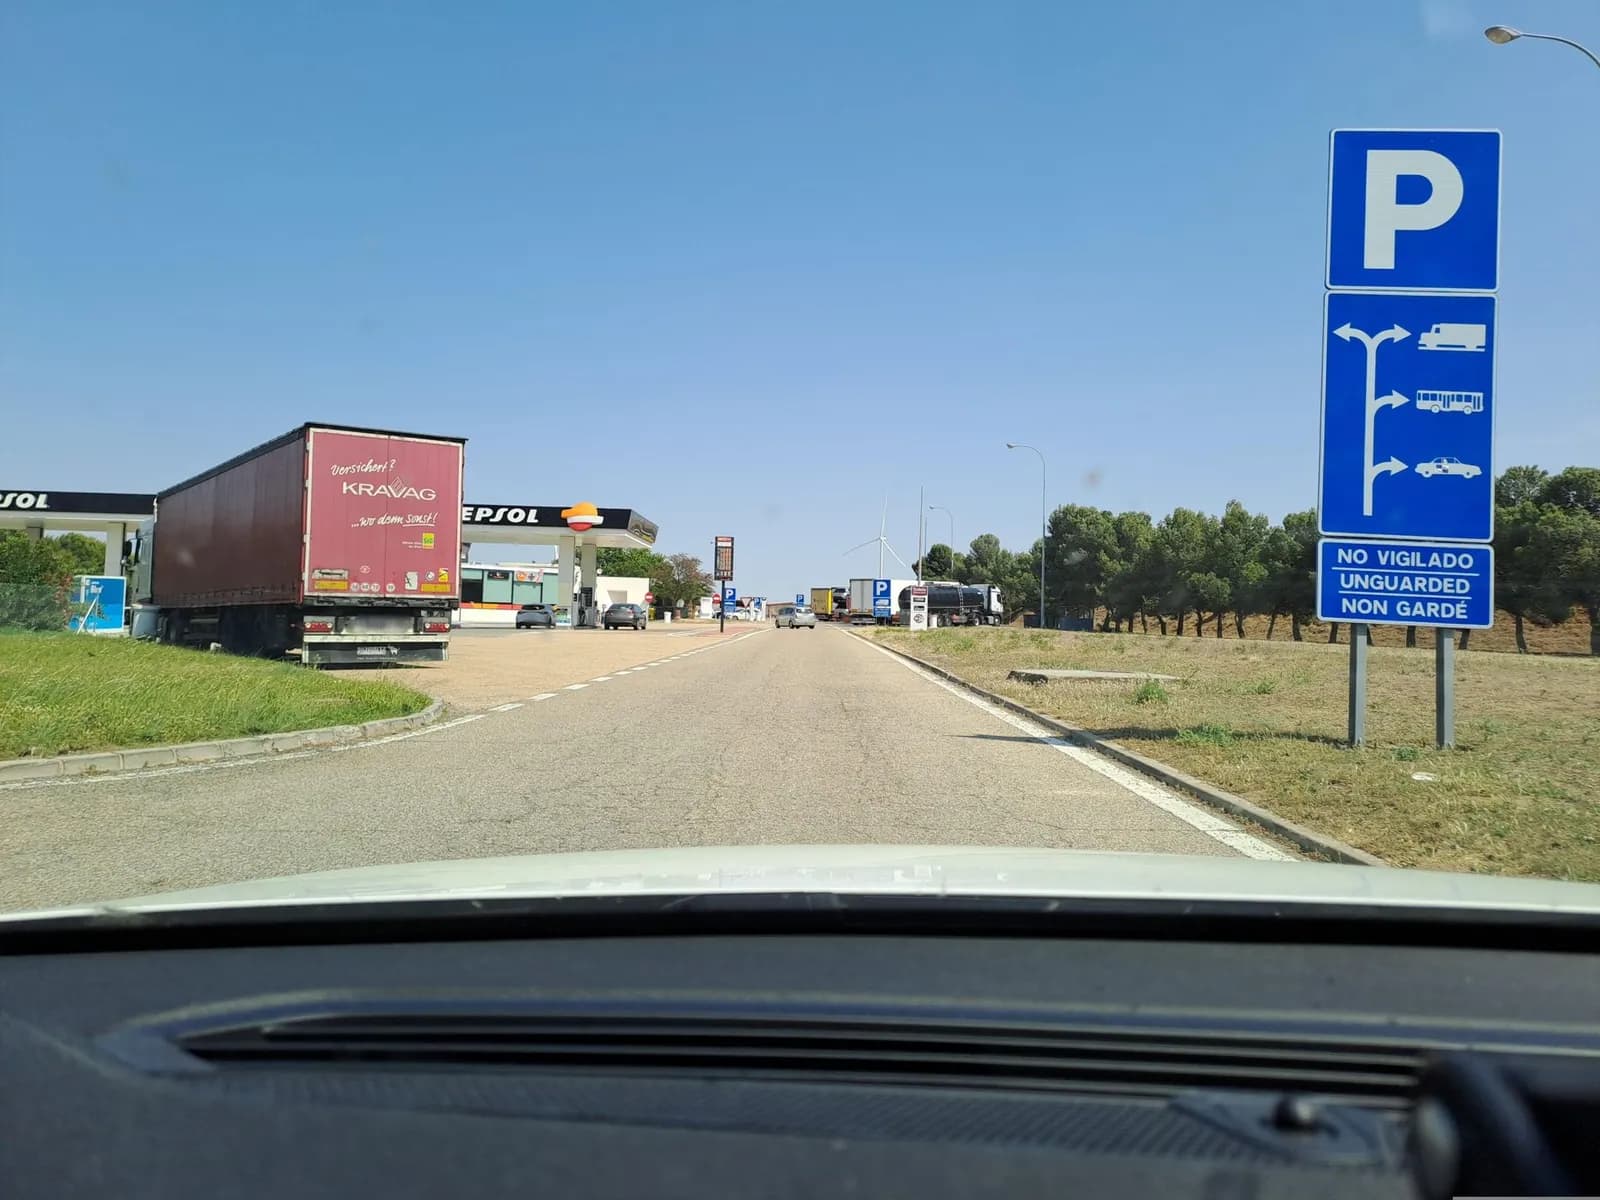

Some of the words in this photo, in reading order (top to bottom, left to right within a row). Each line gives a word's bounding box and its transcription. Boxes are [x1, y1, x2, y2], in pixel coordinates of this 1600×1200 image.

[1363, 149, 1464, 270] P
[0, 492, 50, 509] SOL
[342, 481, 437, 501] KRAVAG
[1337, 548, 1368, 565] NO
[1377, 550, 1474, 569] VIGILADO
[876, 581, 888, 596] P
[1340, 573, 1470, 594] UNGUARDED
[725, 589, 734, 599] P
[1341, 598, 1388, 615] NON
[1396, 600, 1468, 619] GARDÉ
